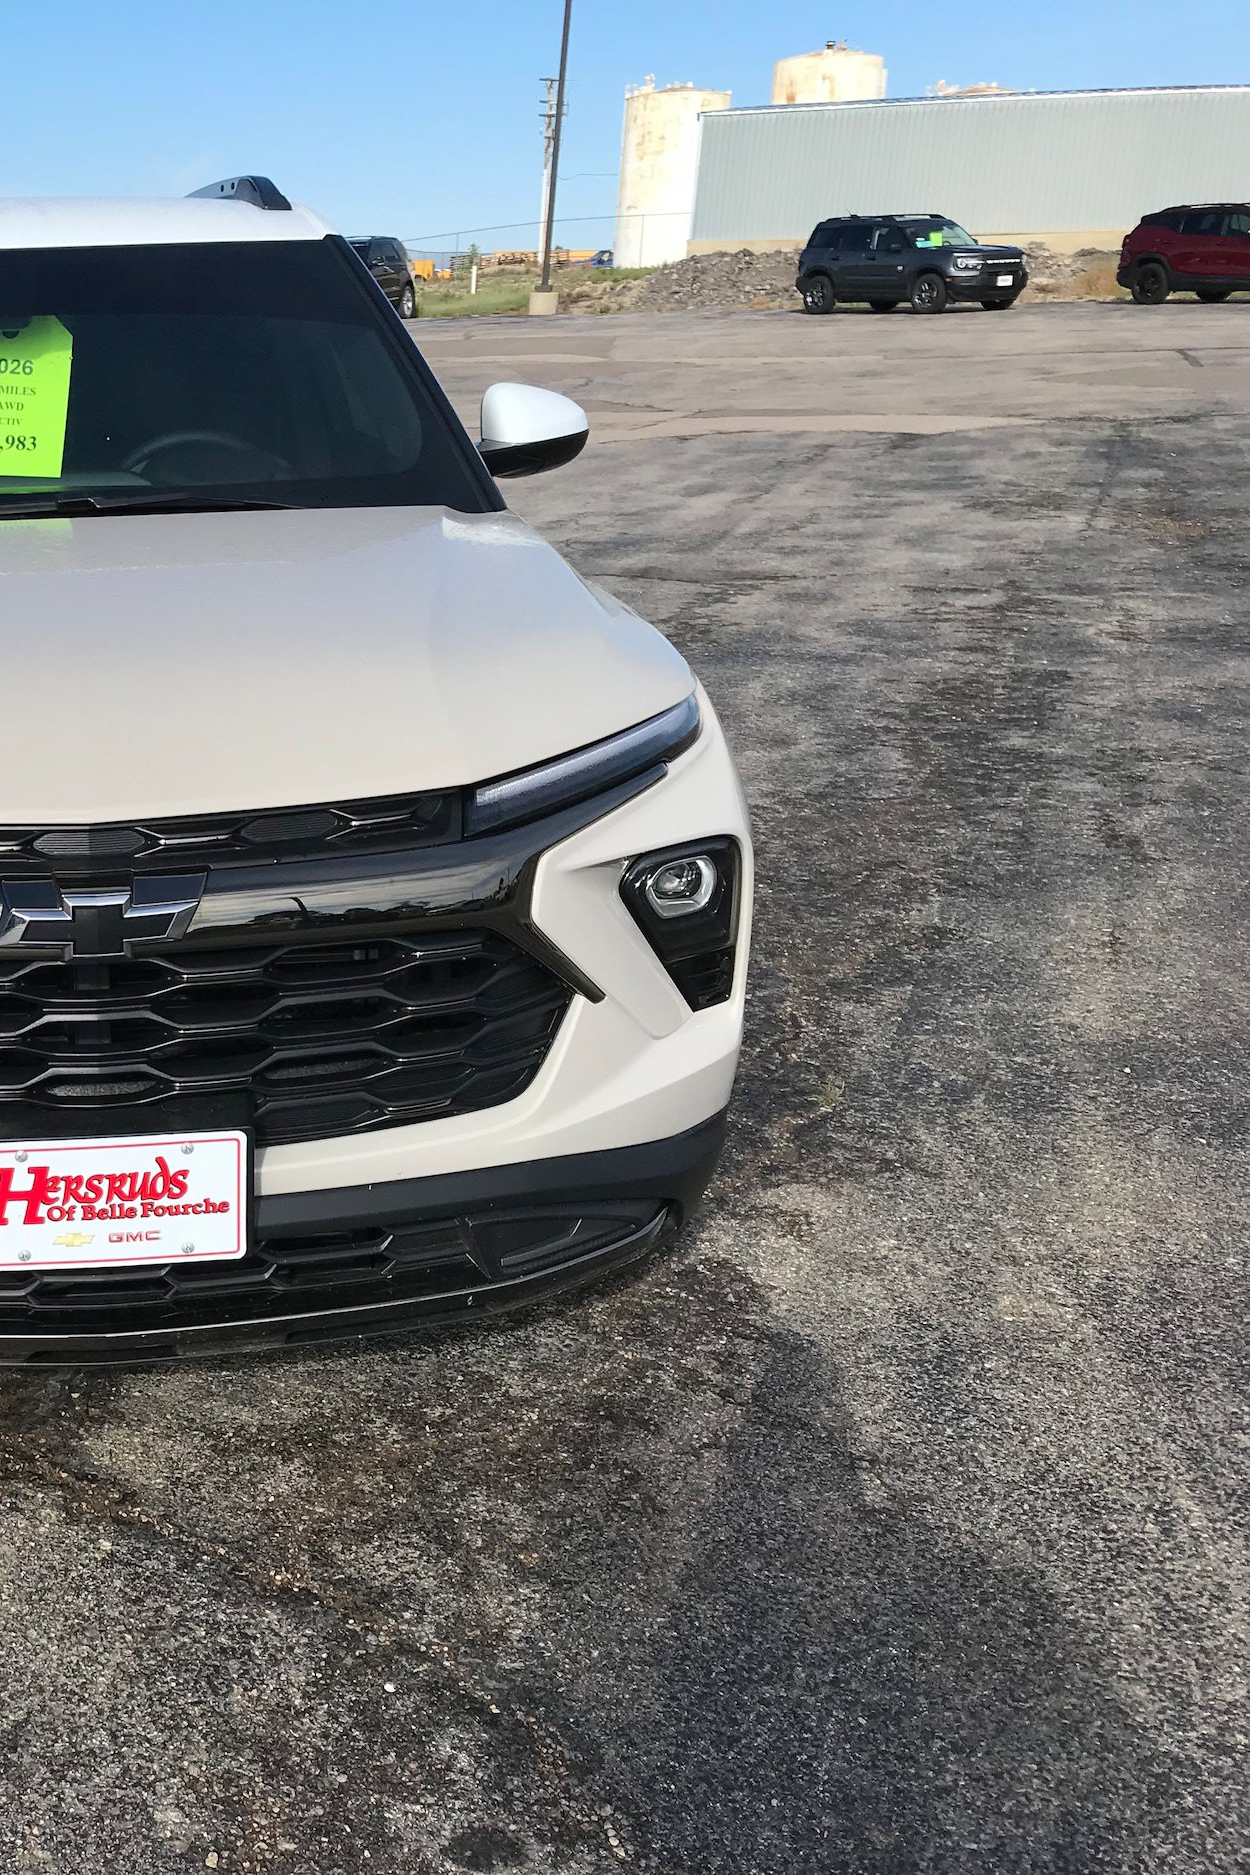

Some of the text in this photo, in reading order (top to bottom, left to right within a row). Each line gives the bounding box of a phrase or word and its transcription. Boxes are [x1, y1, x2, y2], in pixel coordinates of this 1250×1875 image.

[0, 385, 37, 397] MILES
[46, 1197, 231, 1223] Of Belle Fourche
[108, 1230, 162, 1244] GMC
